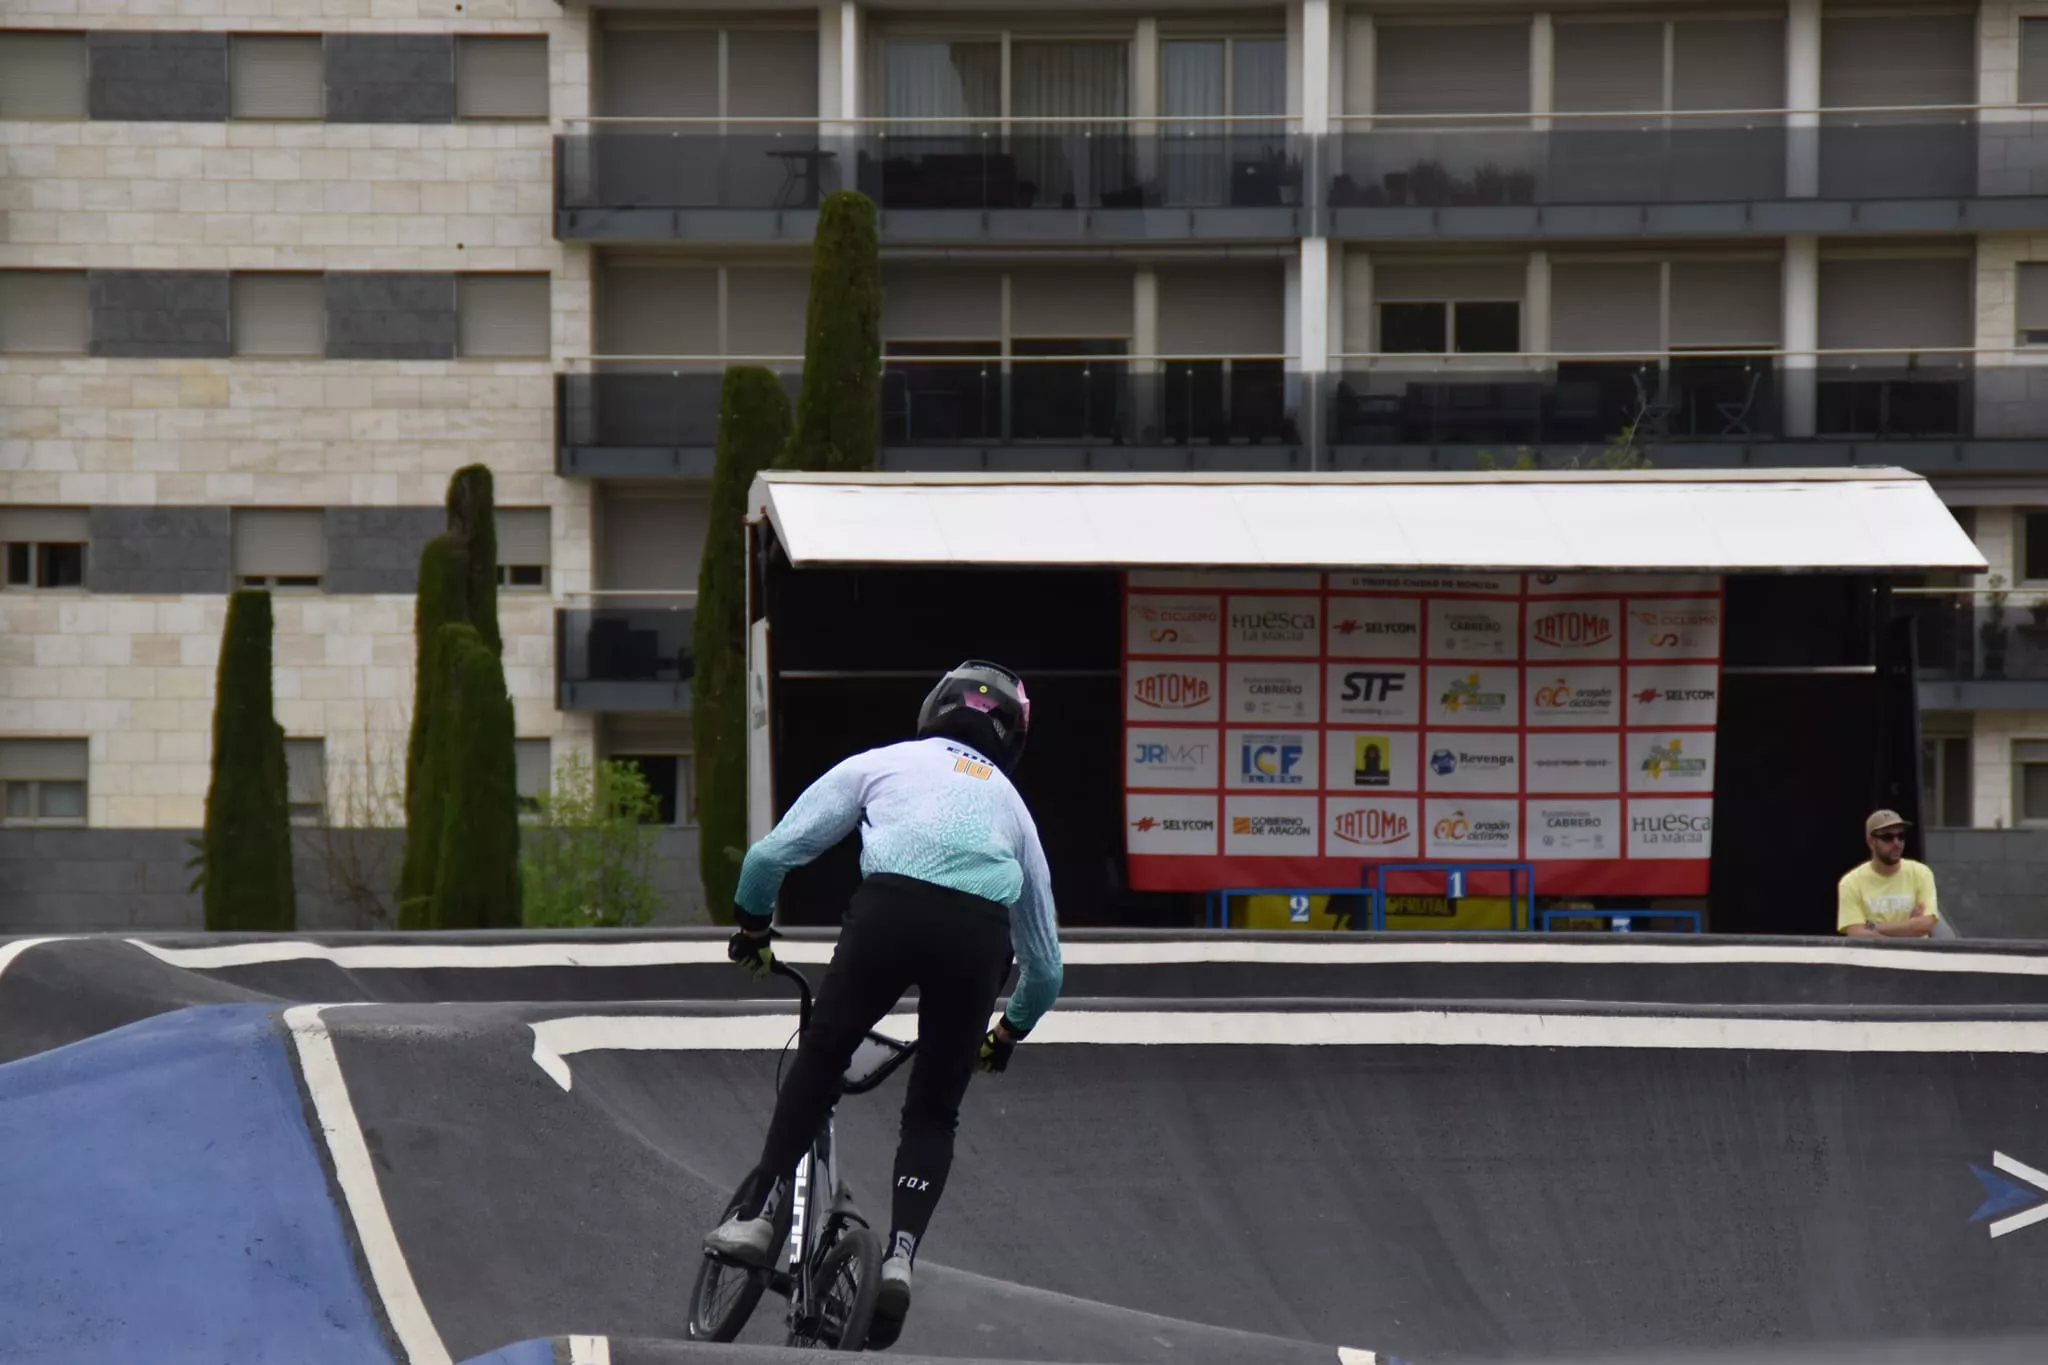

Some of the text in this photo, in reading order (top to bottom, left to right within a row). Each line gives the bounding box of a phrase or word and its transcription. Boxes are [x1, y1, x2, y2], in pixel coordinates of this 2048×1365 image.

[1364, 622, 1417, 634] SELYCOM
[1449, 621, 1501, 633] CABRERO
[1534, 611, 1610, 642] TATOMA
[1135, 673, 1209, 702] TATOMA
[1249, 685, 1302, 695] CABRERO
[1341, 671, 1406, 702] STF
[1664, 690, 1715, 701] SELYCOM
[1135, 743, 1209, 764] JRMKT
[1242, 745, 1303, 774] ICF
[1459, 752, 1515, 767] Revenga
[1162, 820, 1214, 831] SELYCOM
[1251, 816, 1304, 826] GOBIERNO
[1335, 809, 1409, 839] TATOMA
[1547, 818, 1602, 828] CABRERO
[1251, 826, 1264, 836] DE
[1450, 872, 1464, 898] 1
[1290, 897, 1310, 922] 2
[897, 1176, 929, 1191] FOX
